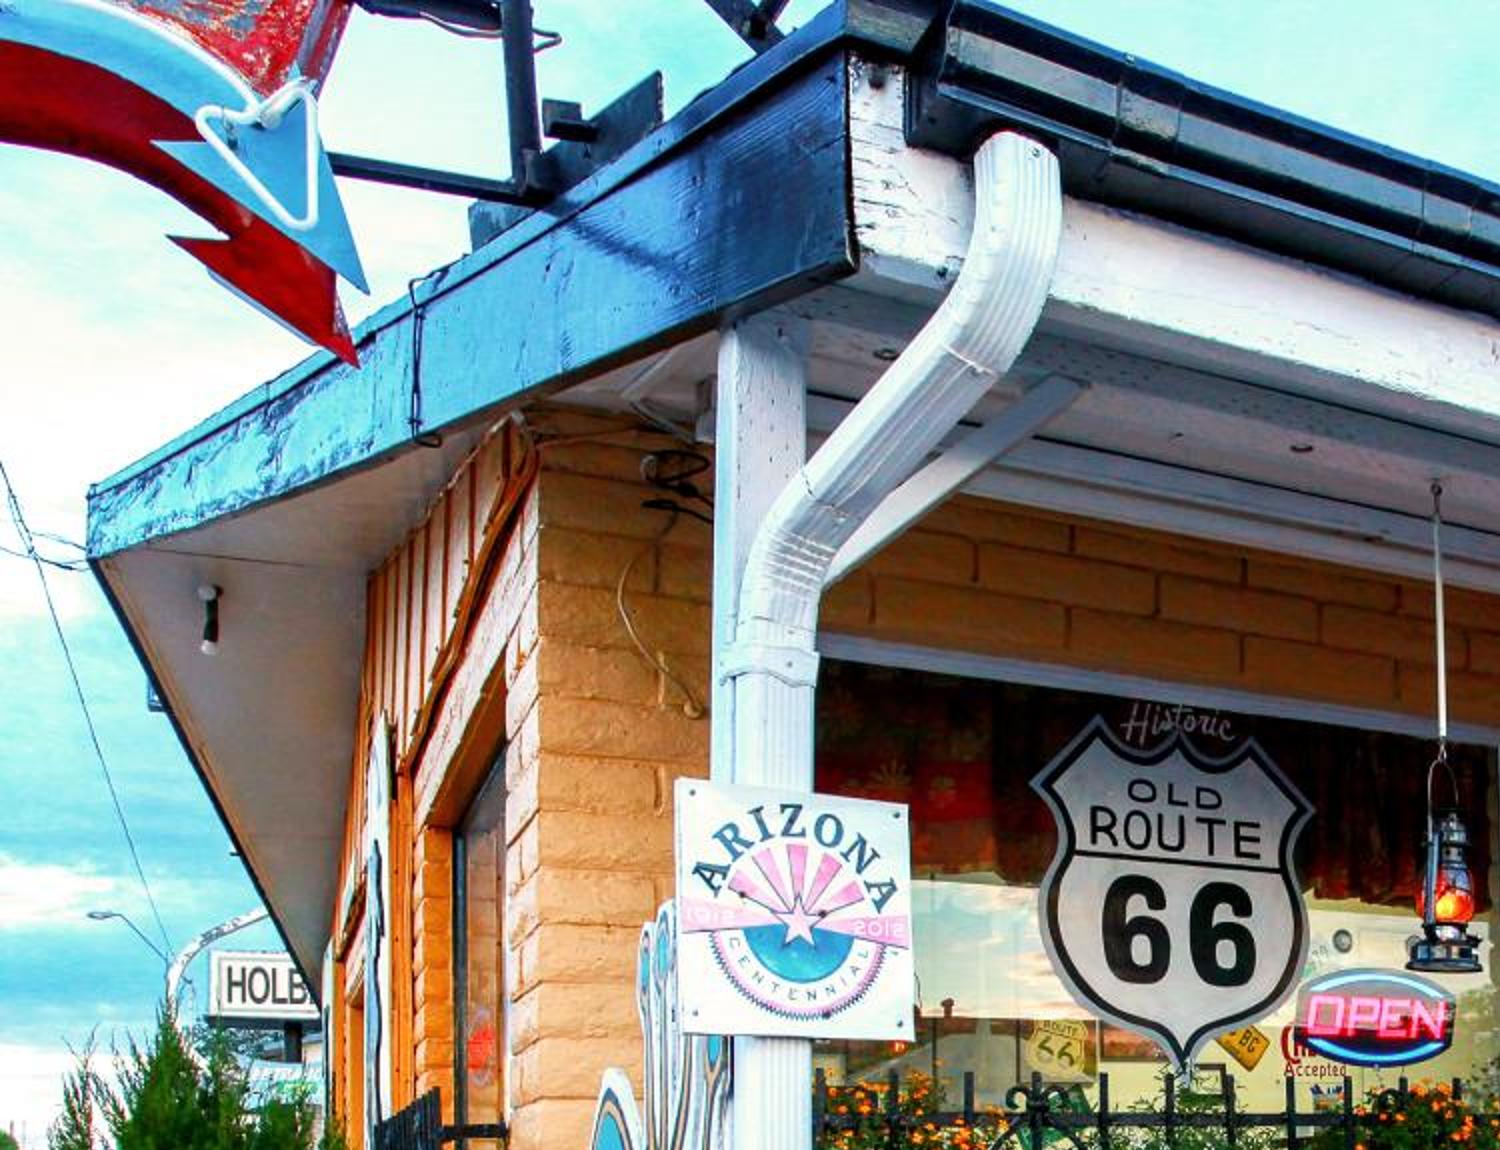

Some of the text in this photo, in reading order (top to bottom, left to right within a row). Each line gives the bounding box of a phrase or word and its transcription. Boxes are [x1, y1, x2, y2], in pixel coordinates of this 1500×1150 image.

[1120, 702, 1235, 744] Historic
[1128, 779, 1223, 811] OLD
[1090, 805, 1261, 860] ROUTE
[692, 803, 898, 914] ARIZONA
[854, 919, 905, 938] 2012
[1102, 874, 1257, 988] 66
[227, 964, 317, 1005] HOLB
[729, 934, 870, 1001] CENTENNIAL
[1308, 995, 1446, 1040] OPEN
[1284, 1061, 1347, 1079] Accepted
